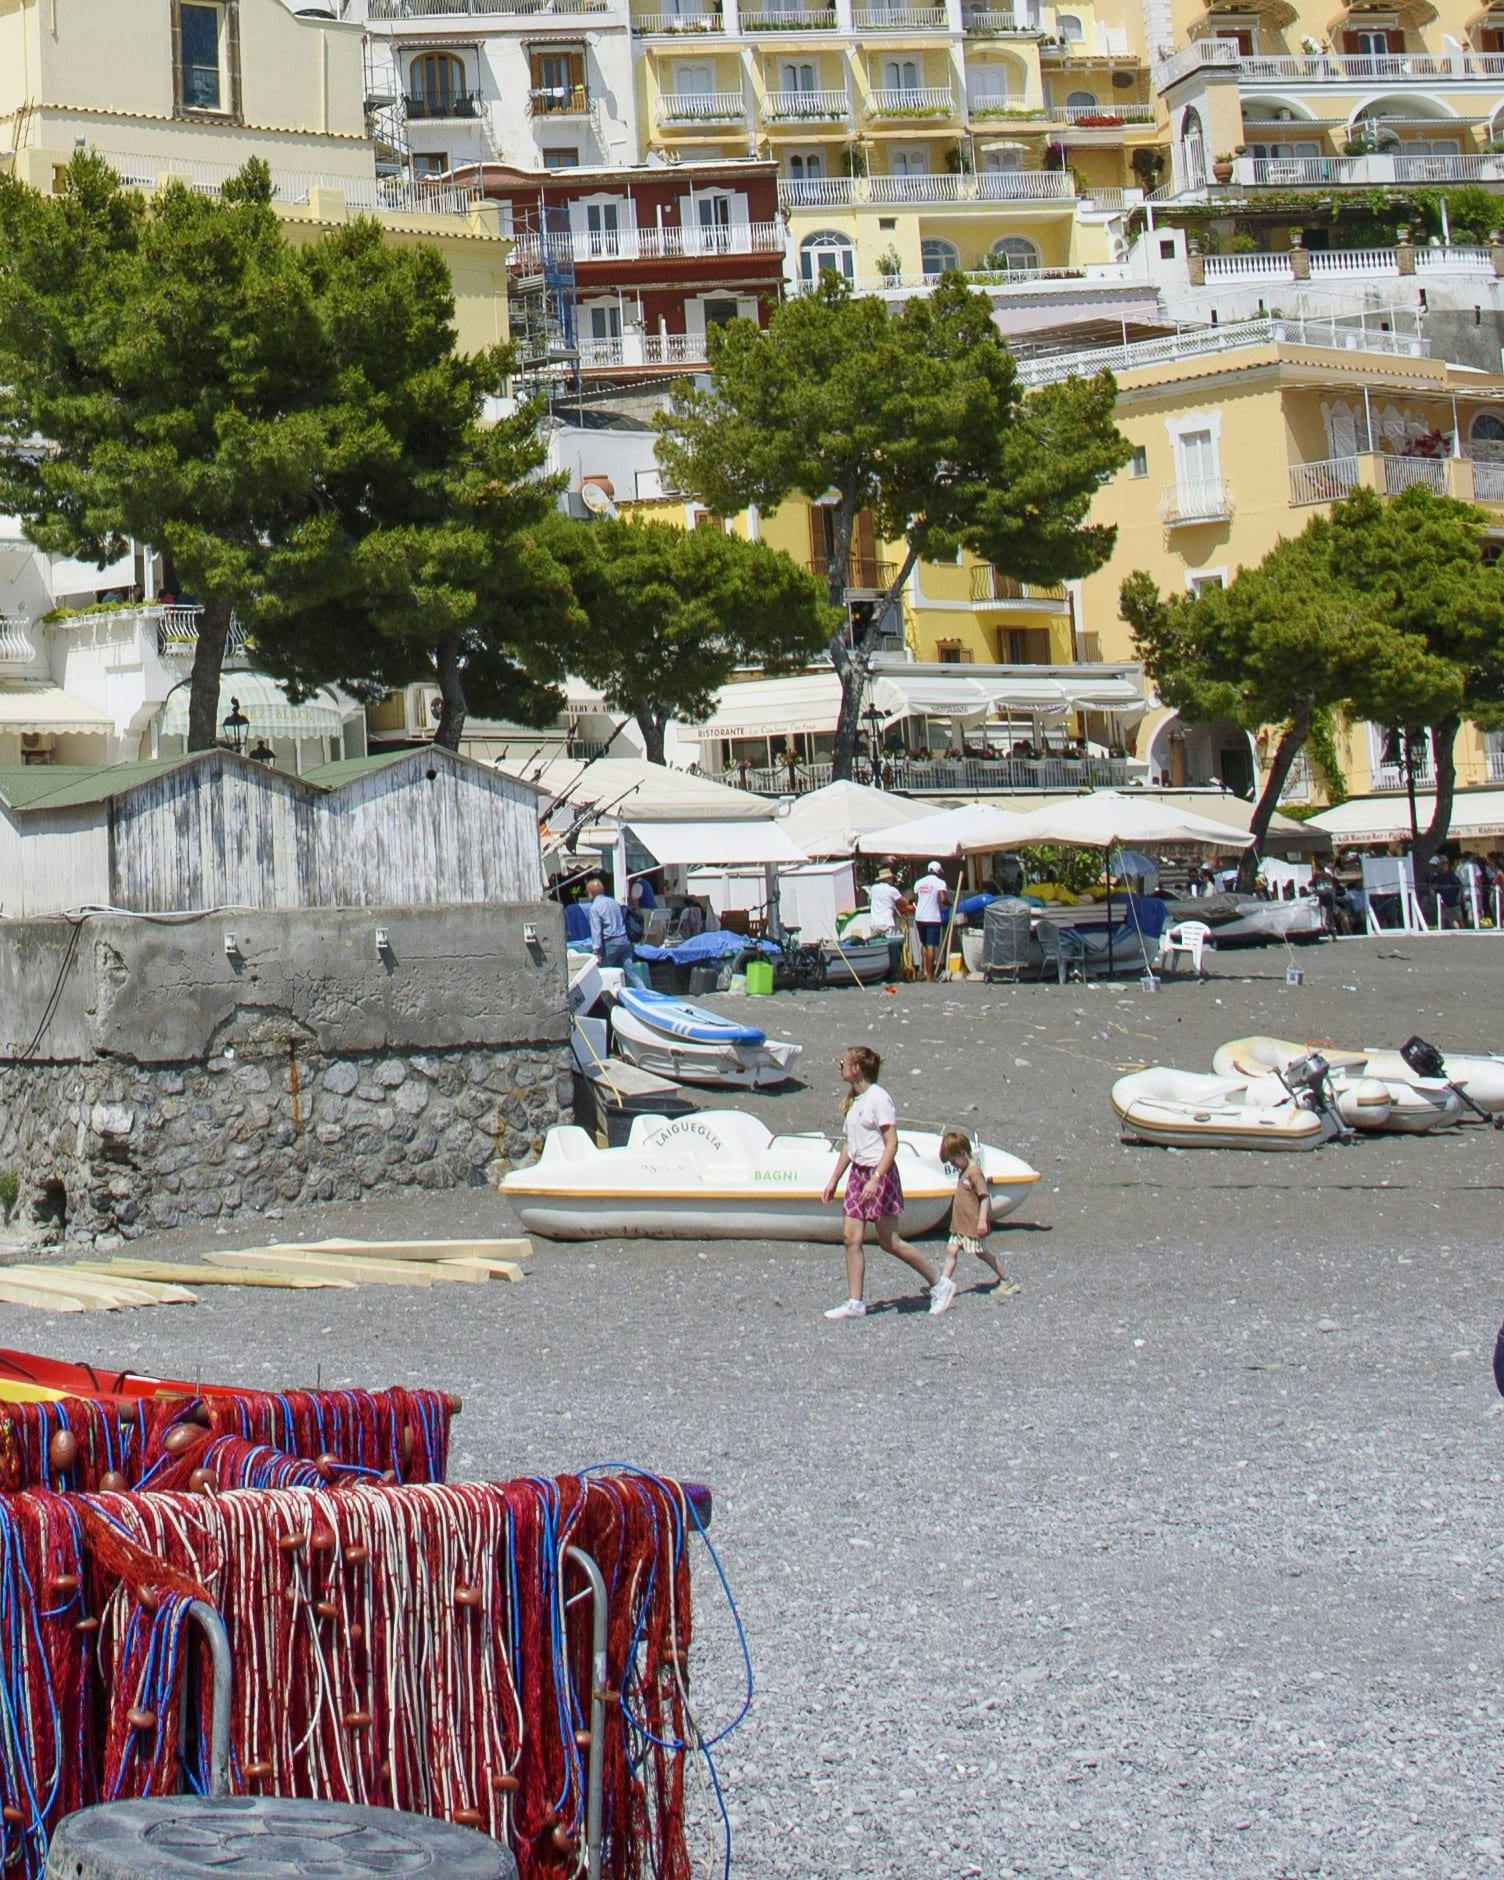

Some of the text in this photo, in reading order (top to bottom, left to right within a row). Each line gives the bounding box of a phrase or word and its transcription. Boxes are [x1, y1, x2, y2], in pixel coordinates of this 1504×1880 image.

[698, 727, 744, 738] RISTORANTE
[655, 1122, 722, 1151] LAIGUEGLIA
[754, 1170, 798, 1181] BAGNI
